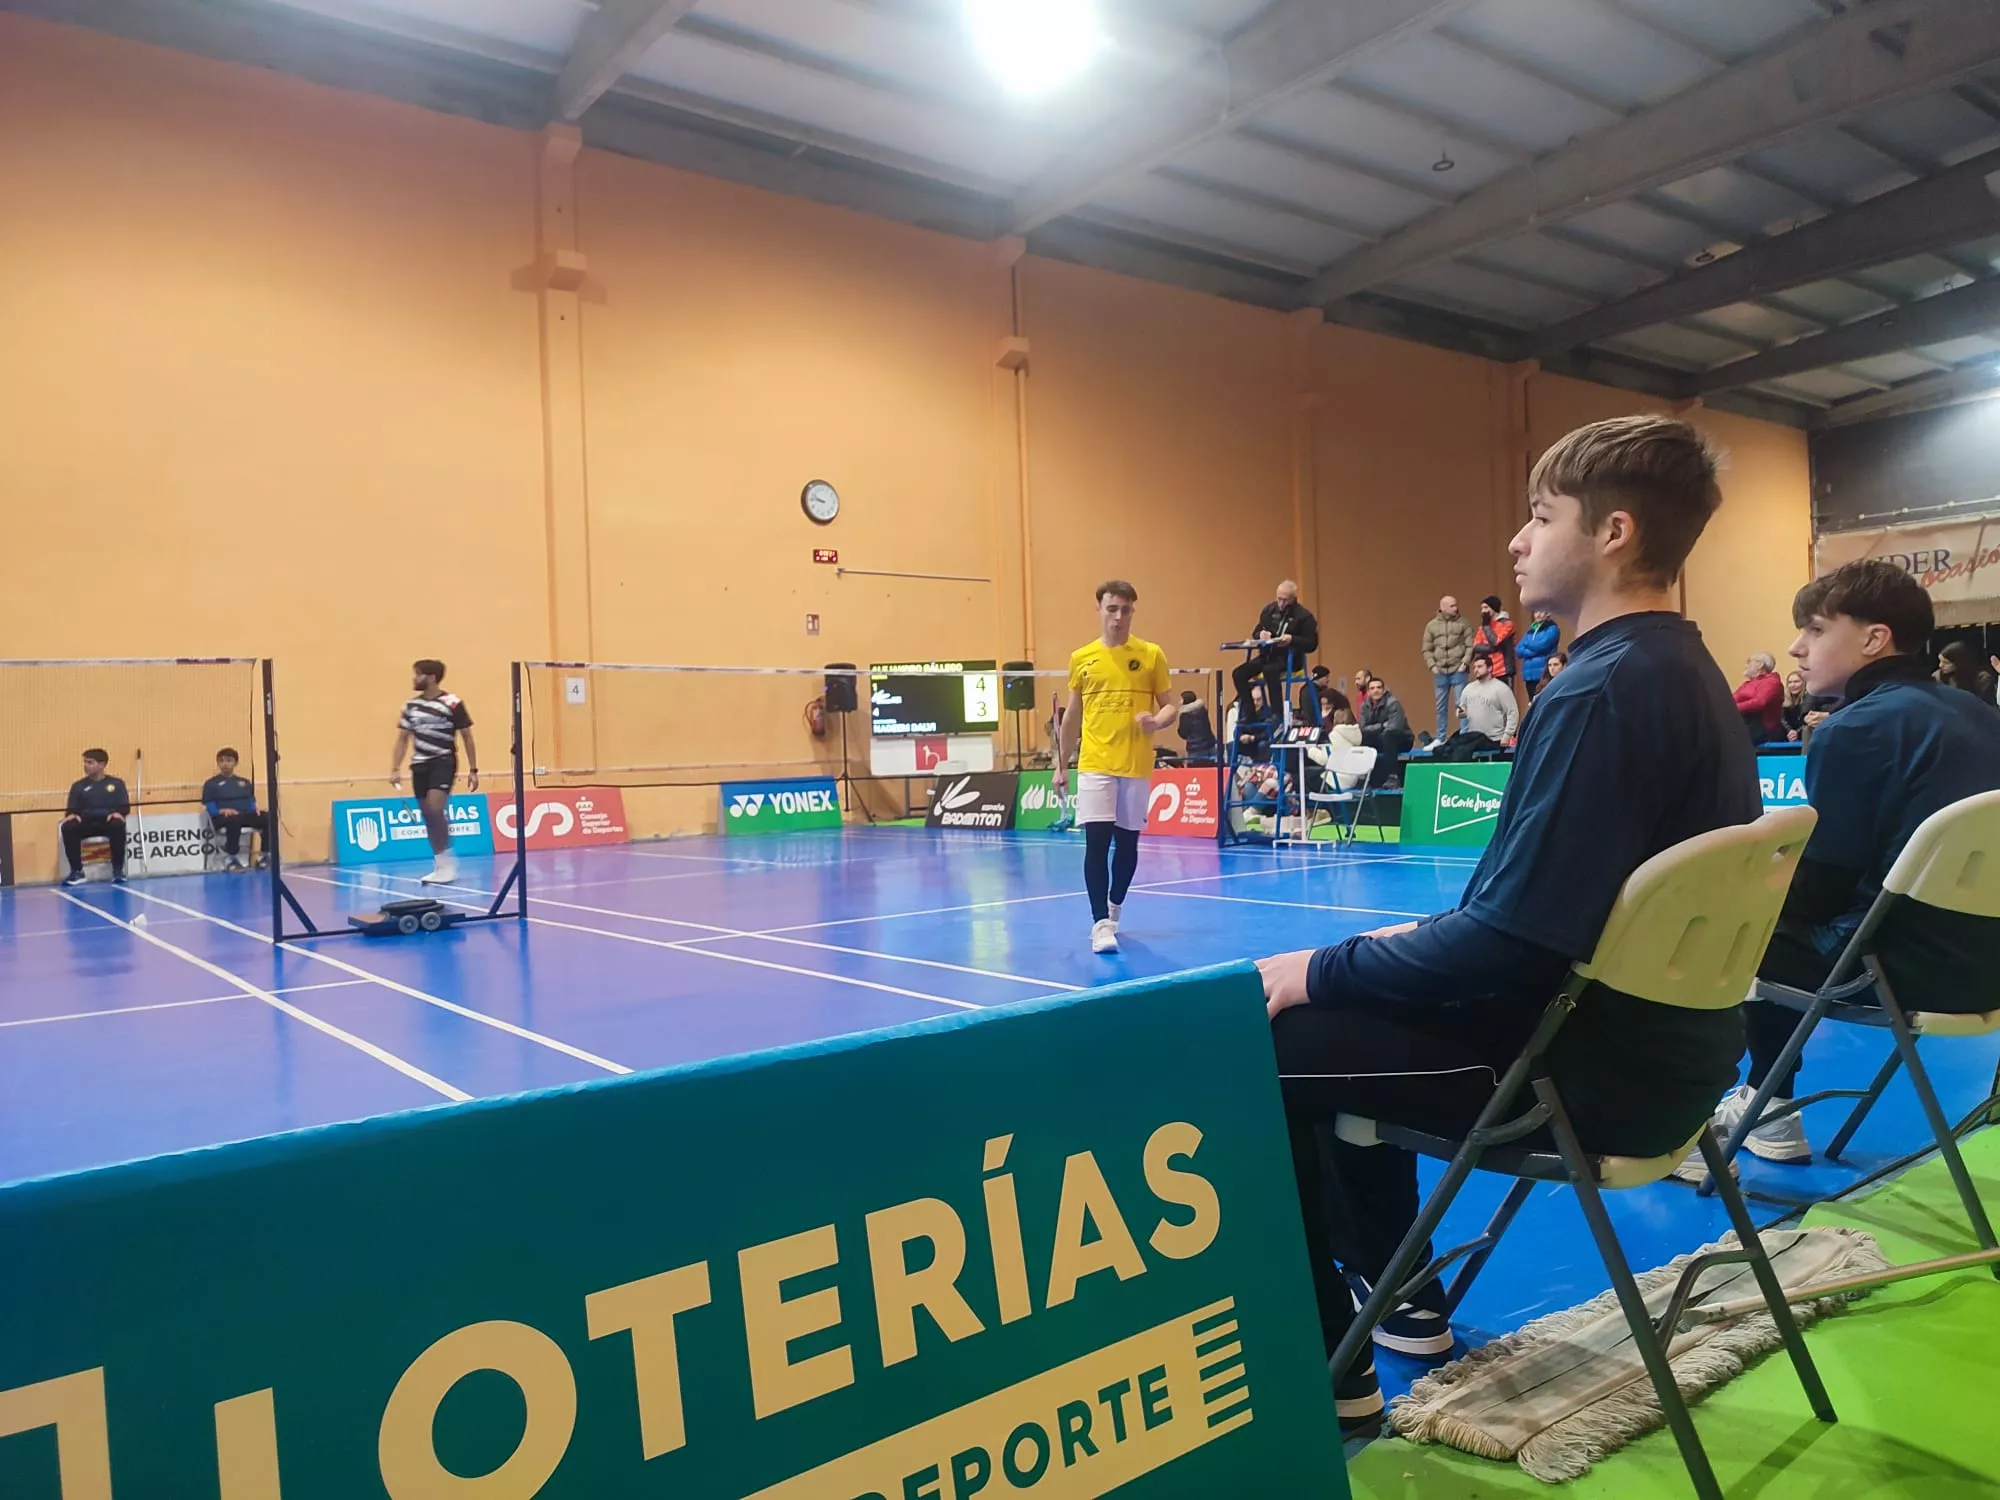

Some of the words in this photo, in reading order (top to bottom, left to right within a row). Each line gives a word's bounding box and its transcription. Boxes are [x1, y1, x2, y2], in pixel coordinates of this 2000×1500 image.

[572, 684, 579, 695] 4
[975, 677, 986, 692] 4
[977, 701, 987, 717] 3
[1289, 728, 1299, 741] 0
[1310, 727, 1320, 741] 0
[768, 790, 835, 815] YONEX
[388, 804, 479, 824] LOTÍAS
[851, 1364, 1173, 1500] EPORTE
